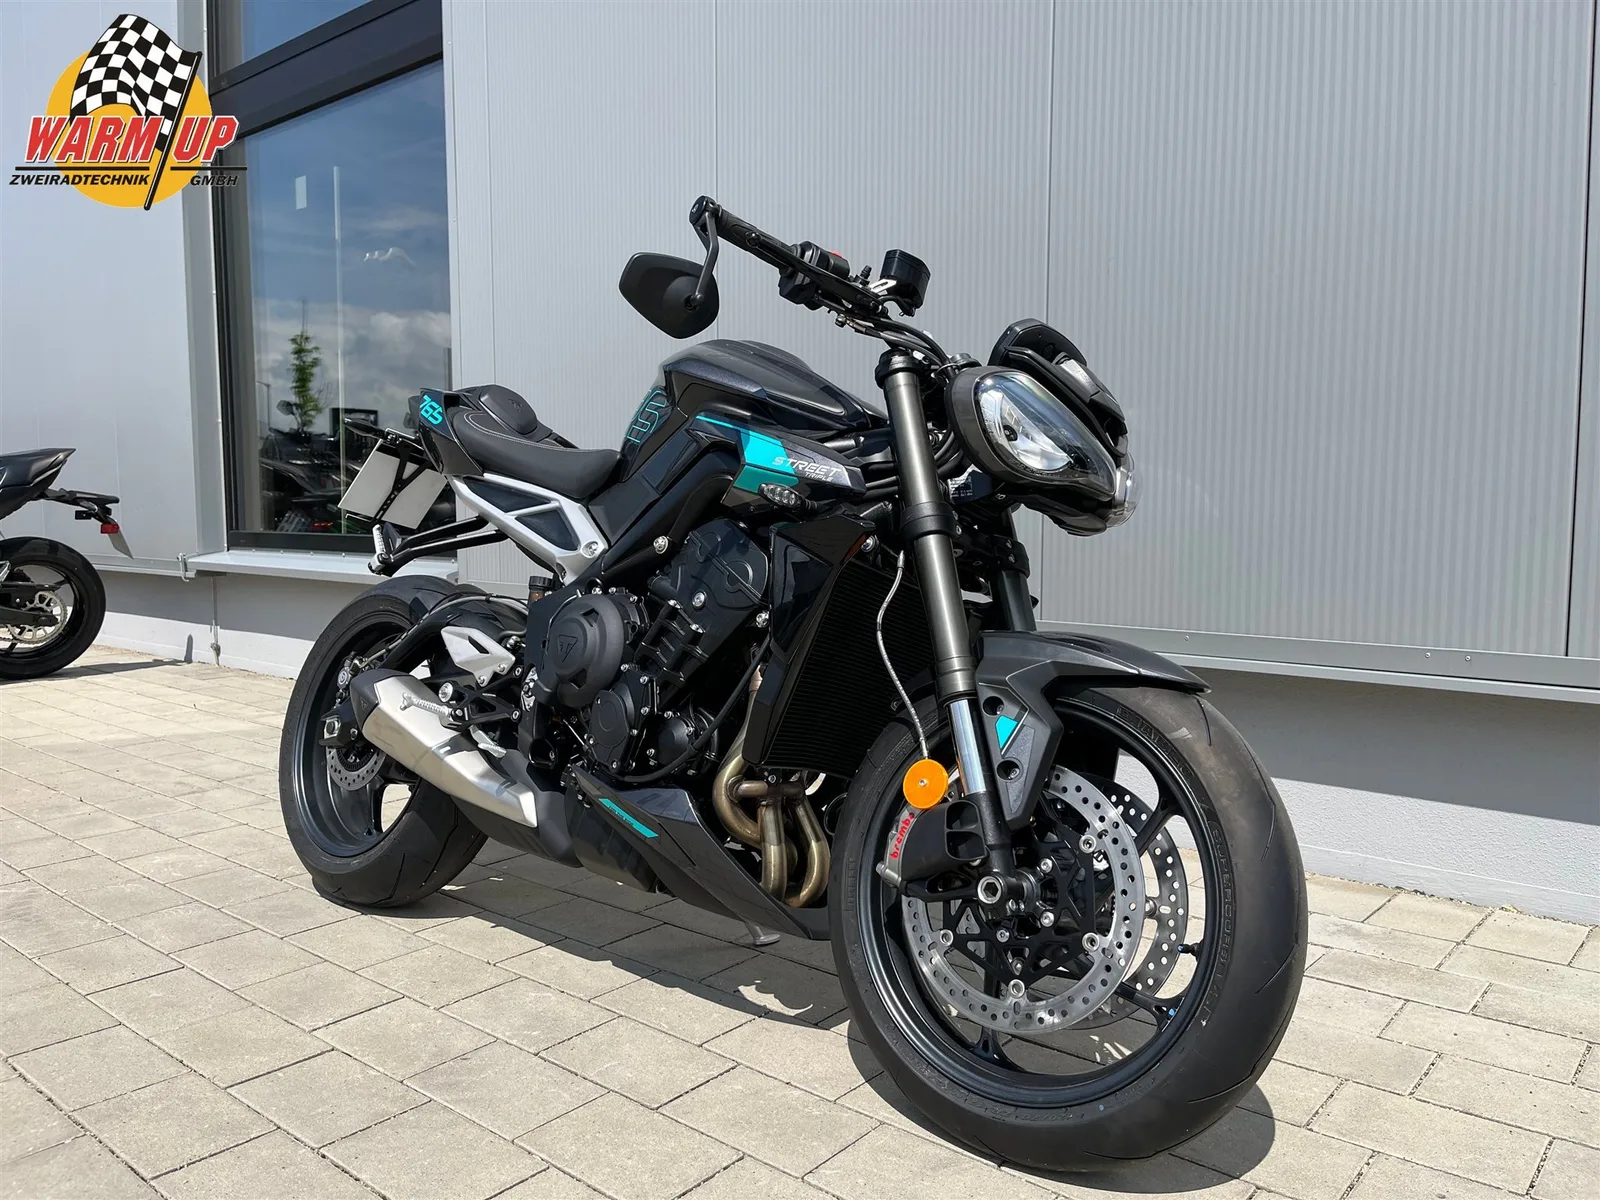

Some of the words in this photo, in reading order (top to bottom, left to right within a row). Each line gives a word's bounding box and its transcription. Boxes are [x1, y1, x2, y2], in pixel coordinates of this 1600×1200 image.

[419, 394, 444, 425] 765
[772, 457, 842, 477] STREET
[805, 472, 834, 482] TRIPLE
[890, 812, 915, 859] brembo
